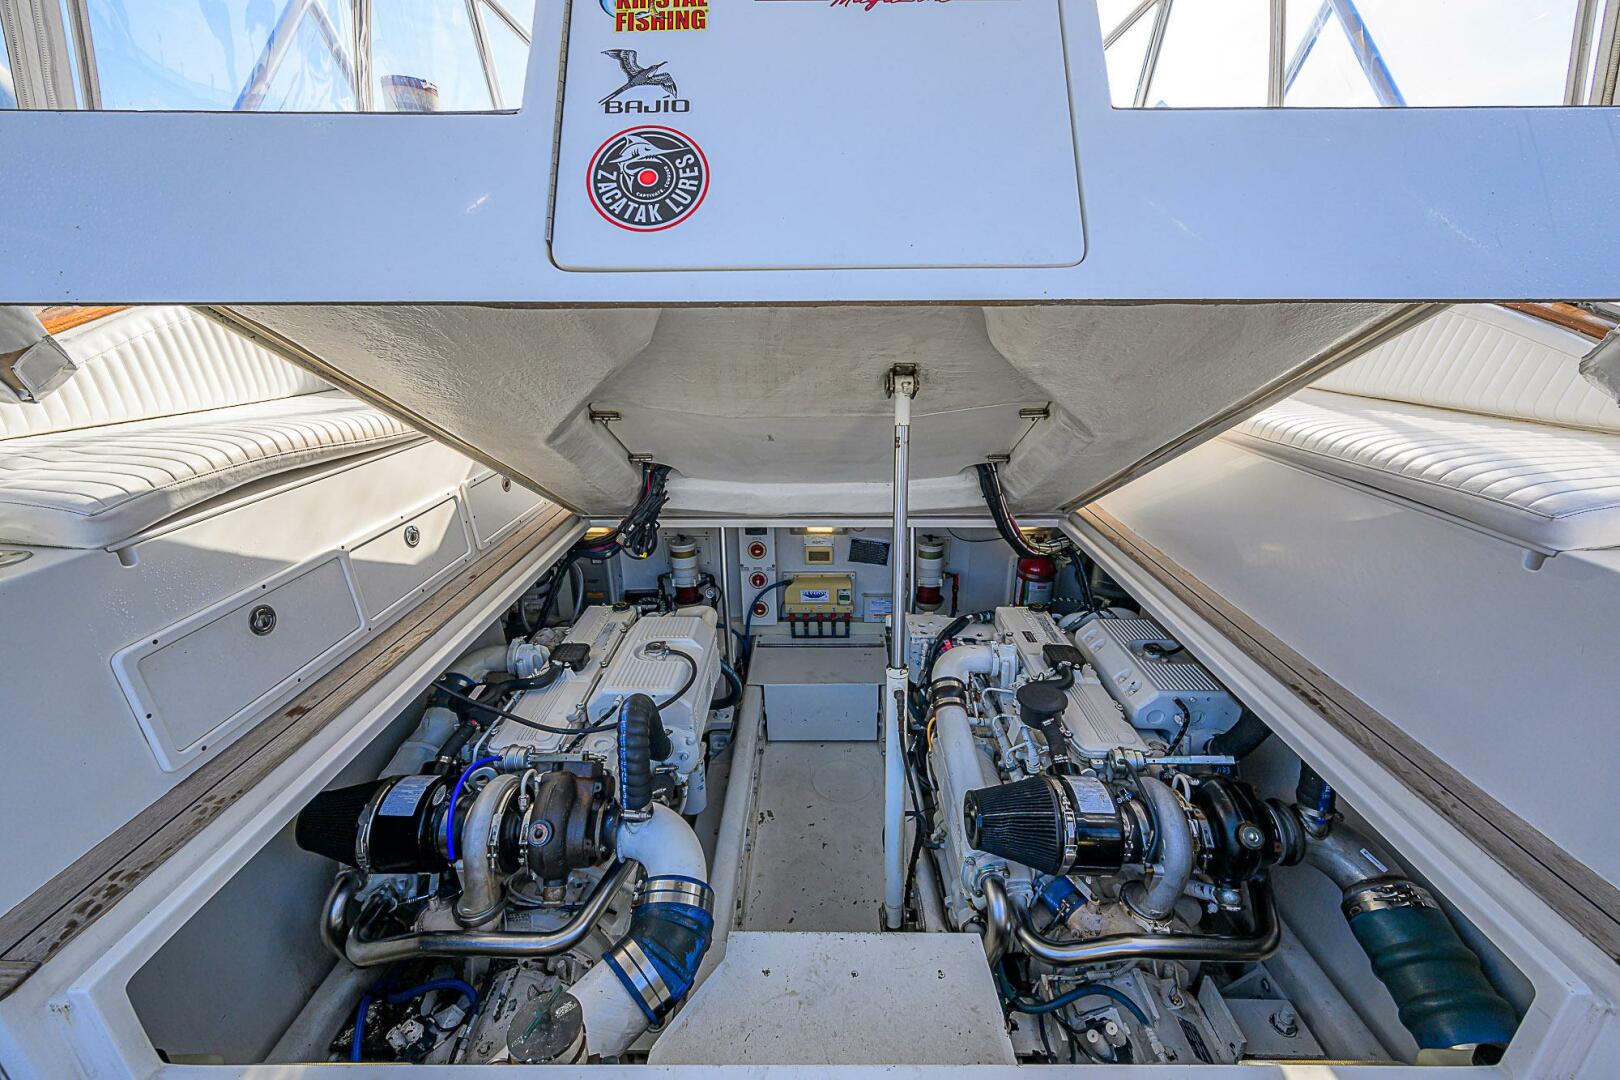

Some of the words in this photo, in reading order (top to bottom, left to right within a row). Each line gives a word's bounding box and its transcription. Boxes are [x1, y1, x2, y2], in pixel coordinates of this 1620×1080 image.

[614, 9, 706, 32] FISHING
[597, 169, 663, 223] ZACATAK
[665, 153, 699, 214] LURES
